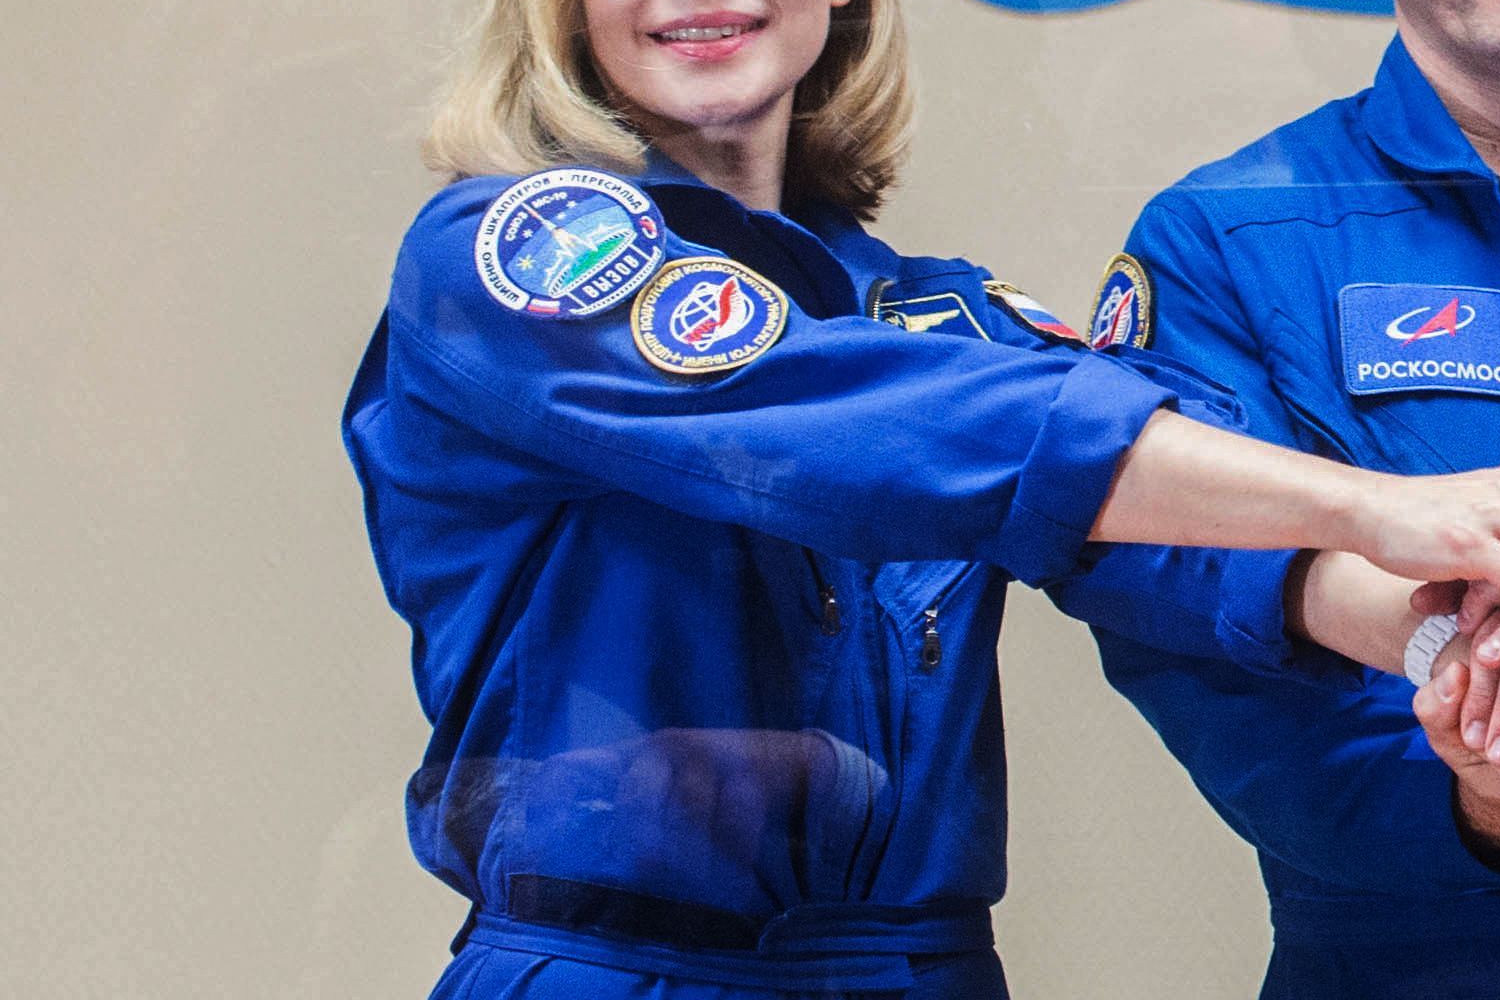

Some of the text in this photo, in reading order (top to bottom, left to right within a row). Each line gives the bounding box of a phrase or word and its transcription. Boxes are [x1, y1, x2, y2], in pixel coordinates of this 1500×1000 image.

[487, 177, 551, 237] ШКАПЛЕРОВ
[570, 174, 643, 211] ПЕРЕСИЛЬД
[582, 254, 640, 299] ВЫЗОВ
